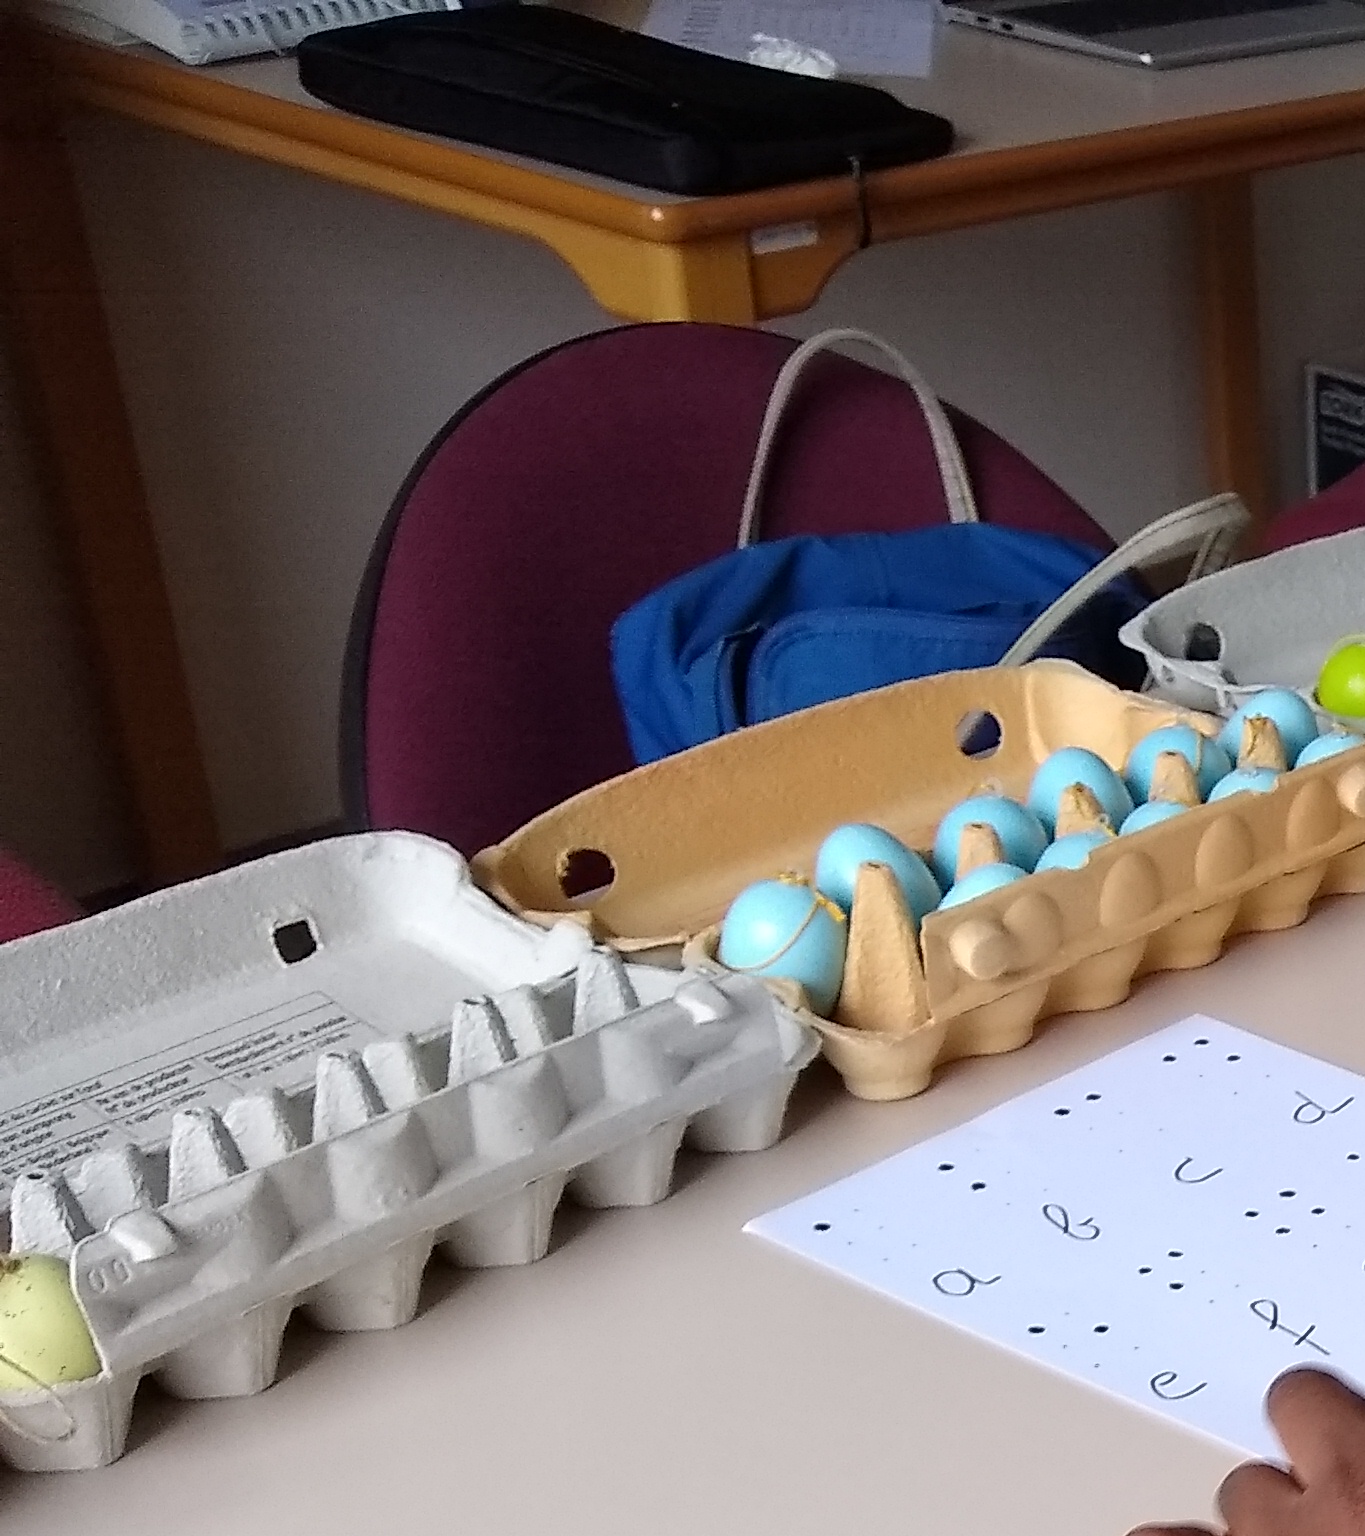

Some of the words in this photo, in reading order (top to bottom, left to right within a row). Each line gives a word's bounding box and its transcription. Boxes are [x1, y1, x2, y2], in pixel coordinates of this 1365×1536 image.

[931, 1268, 1002, 1297] a
[1173, 1156, 1224, 1184] c
[1292, 1090, 1355, 1124] d
[1149, 1370, 1208, 1400] e
